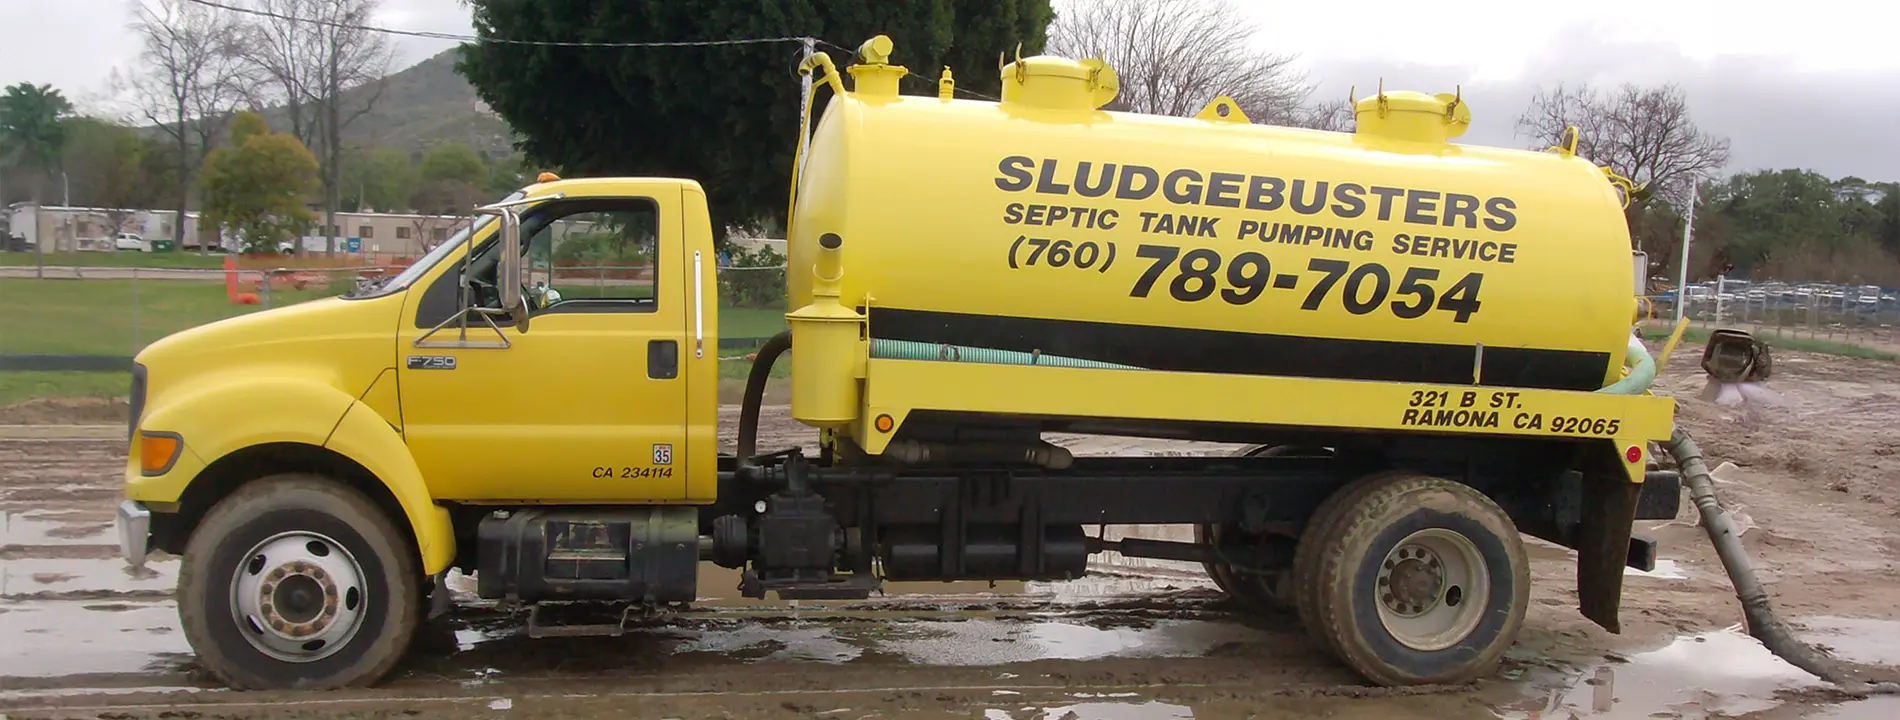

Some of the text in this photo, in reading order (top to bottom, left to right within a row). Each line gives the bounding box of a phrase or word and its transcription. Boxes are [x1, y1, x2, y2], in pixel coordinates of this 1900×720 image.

[994, 155, 1517, 232] SLUDGEBUSTERS
[1003, 203, 1517, 264] SEPTIC TANK PUMPING SERVICE
[1007, 235, 1485, 324] (760) 789-7054
[1409, 390, 1523, 409] 321 B ST.
[1401, 409, 1620, 435] RAMONA CA 92065
[655, 450, 669, 463] 35
[592, 467, 672, 478] CA 234114
